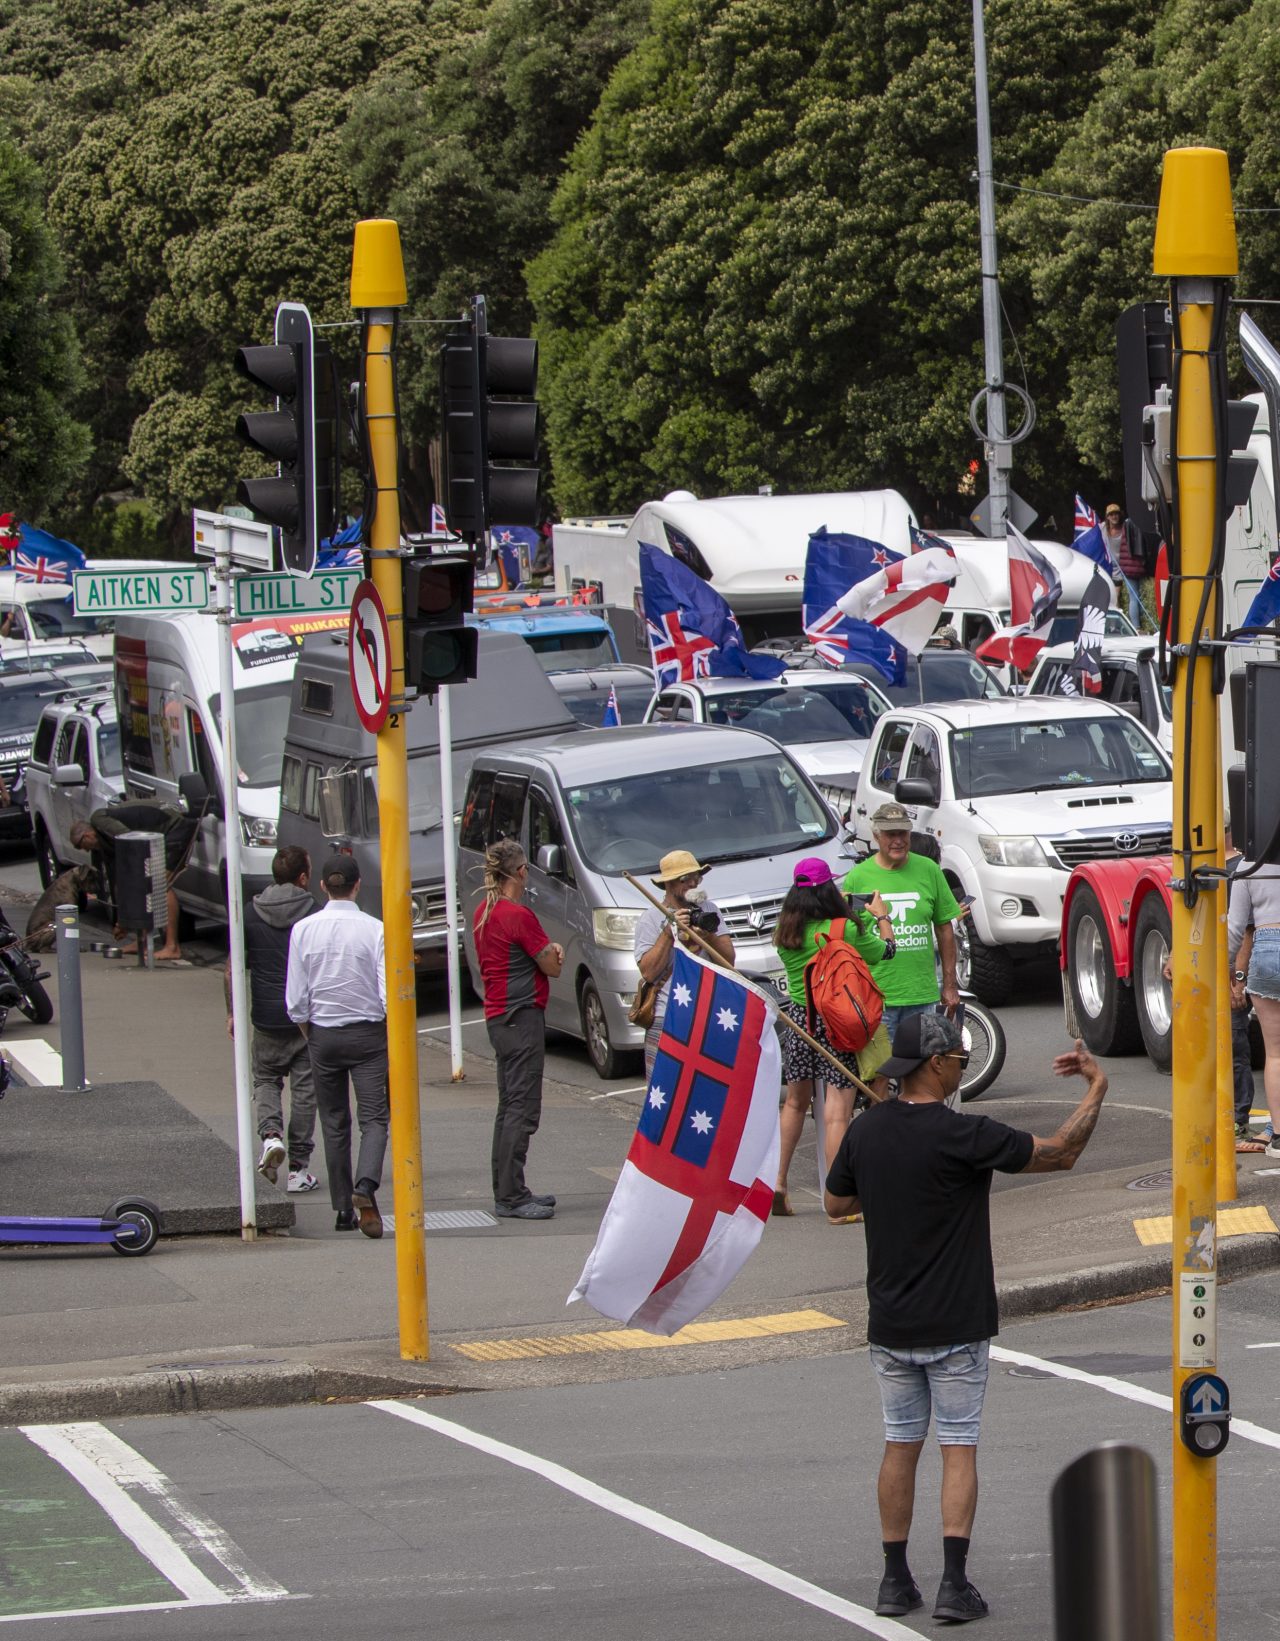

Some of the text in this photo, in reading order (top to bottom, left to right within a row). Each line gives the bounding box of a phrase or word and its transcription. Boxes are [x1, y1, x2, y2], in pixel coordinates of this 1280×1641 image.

[88, 576, 195, 606] AITKEN ST
[251, 577, 349, 610] HILL ST
[250, 654, 286, 666] FURNITURE
[389, 713, 400, 728] 2
[1192, 825, 1203, 846] 1
[872, 923, 928, 936] Otdoors
[895, 935, 928, 947] eedom
